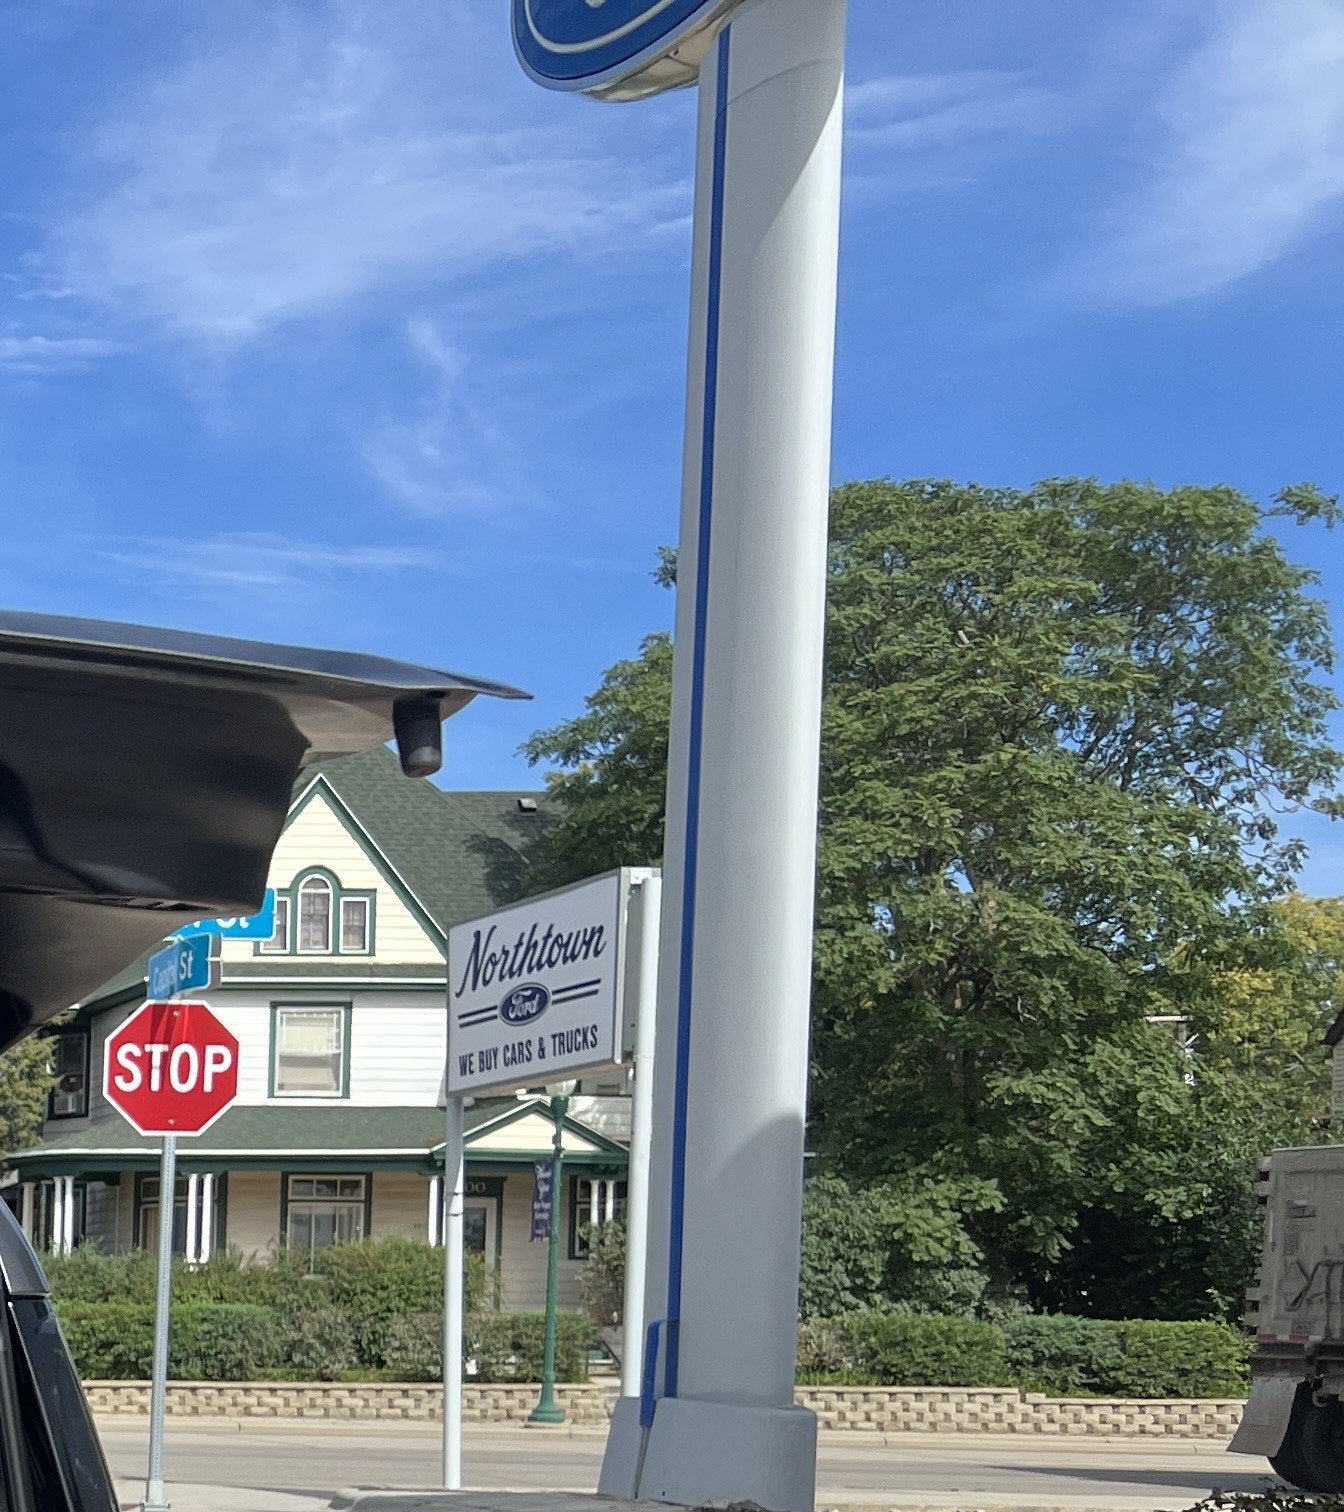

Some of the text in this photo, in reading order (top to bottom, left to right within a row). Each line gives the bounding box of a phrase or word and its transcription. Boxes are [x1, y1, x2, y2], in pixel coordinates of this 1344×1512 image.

[179, 948, 193, 980] St
[455, 923, 606, 998] Northtown
[508, 989, 540, 1019] Ford
[114, 1042, 232, 1094] STOP
[459, 1024, 598, 1077] WE BUY CARS & TRUCKS
